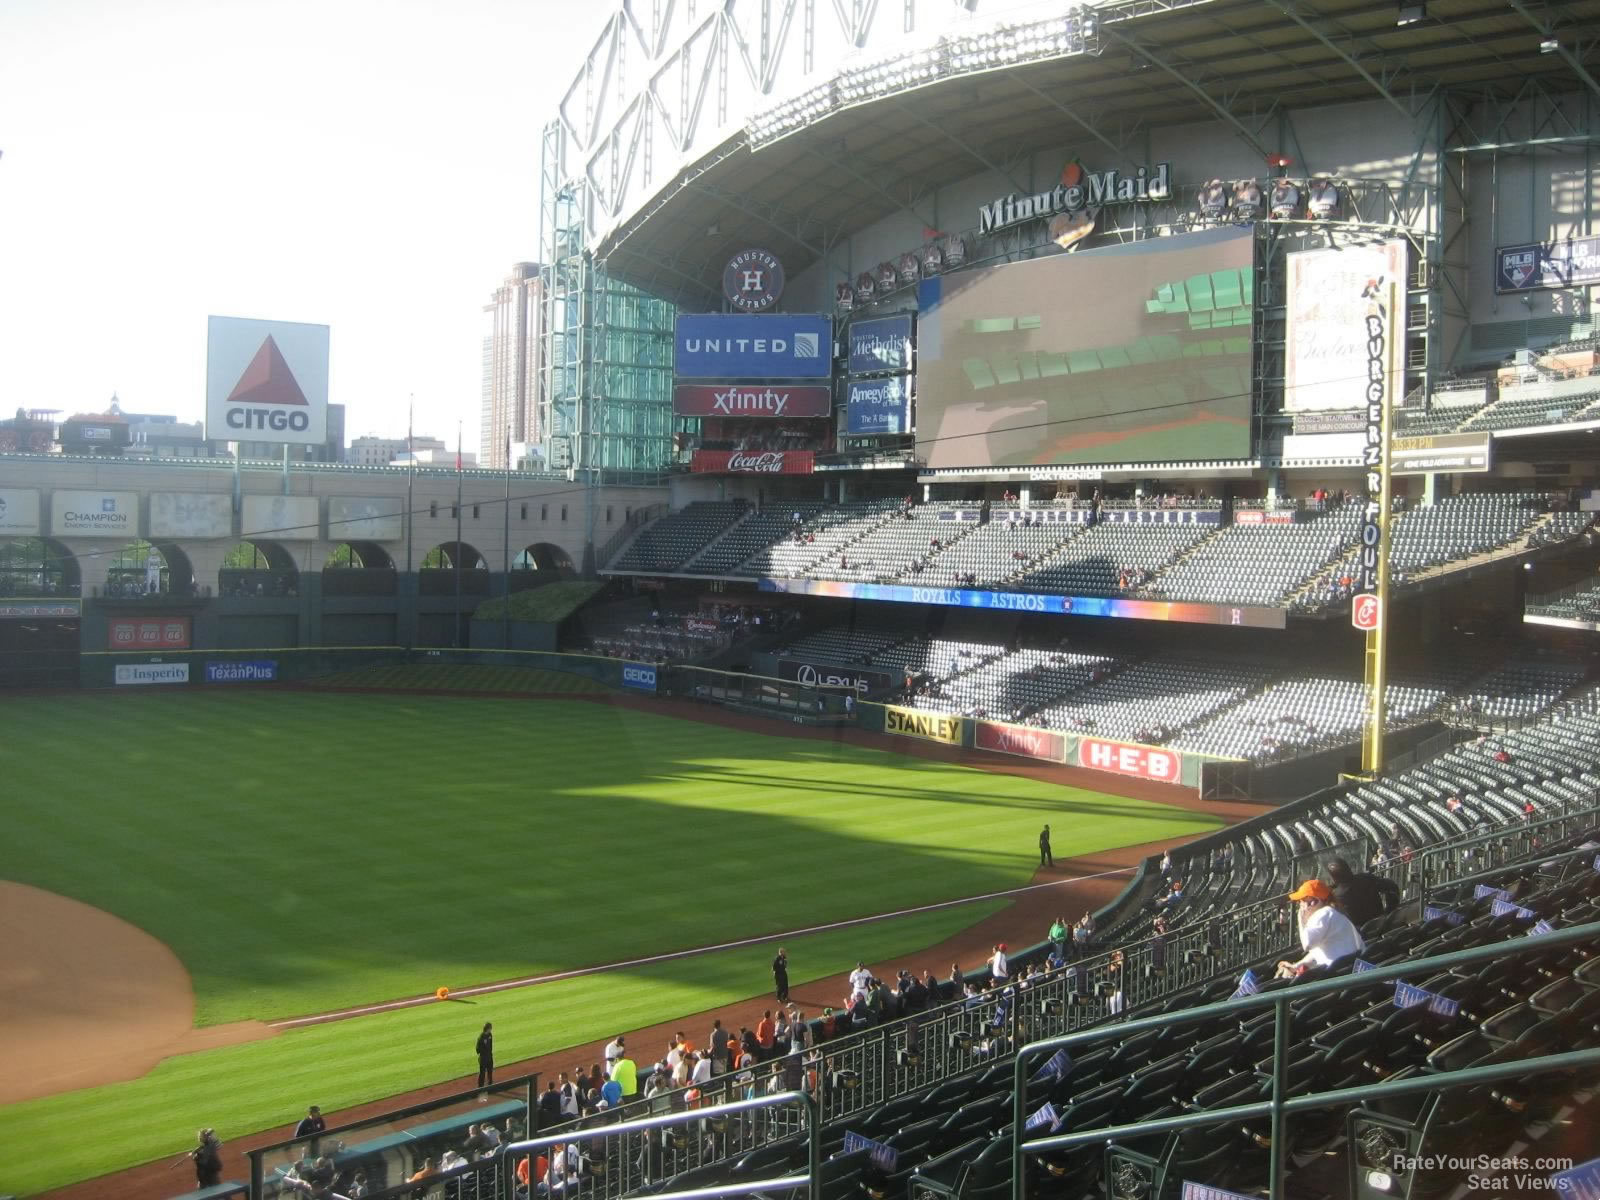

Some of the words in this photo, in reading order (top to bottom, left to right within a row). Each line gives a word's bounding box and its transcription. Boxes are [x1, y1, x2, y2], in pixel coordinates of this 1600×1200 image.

[978, 183, 1082, 236] Minute
[1086, 163, 1172, 208] Maid
[730, 252, 777, 270] HOUSTON
[1505, 253, 1533, 267] MLB
[741, 270, 763, 291] H
[732, 293, 774, 308] ASTROS
[685, 338, 788, 354] UNITED
[852, 333, 908, 357] Methodist
[1364, 315, 1385, 466] BURGERZ
[713, 387, 790, 415] xfinity
[226, 407, 310, 431] CITGO
[1418, 437, 1433, 449] PM
[1029, 471, 1102, 481] DAKTRONICS
[64, 511, 127, 522] CHAMPION
[1123, 511, 1197, 523] ASTROS
[1363, 501, 1381, 590] FOUL
[912, 587, 961, 605] ROYALS
[991, 592, 1045, 611] ASTROS
[134, 666, 187, 681] Insperity
[209, 665, 272, 680] TexanPlus
[623, 667, 656, 685] GEICO
[818, 673, 869, 692] LEXUS
[887, 710, 960, 741] STANLEY
[997, 727, 1042, 755] xfinity
